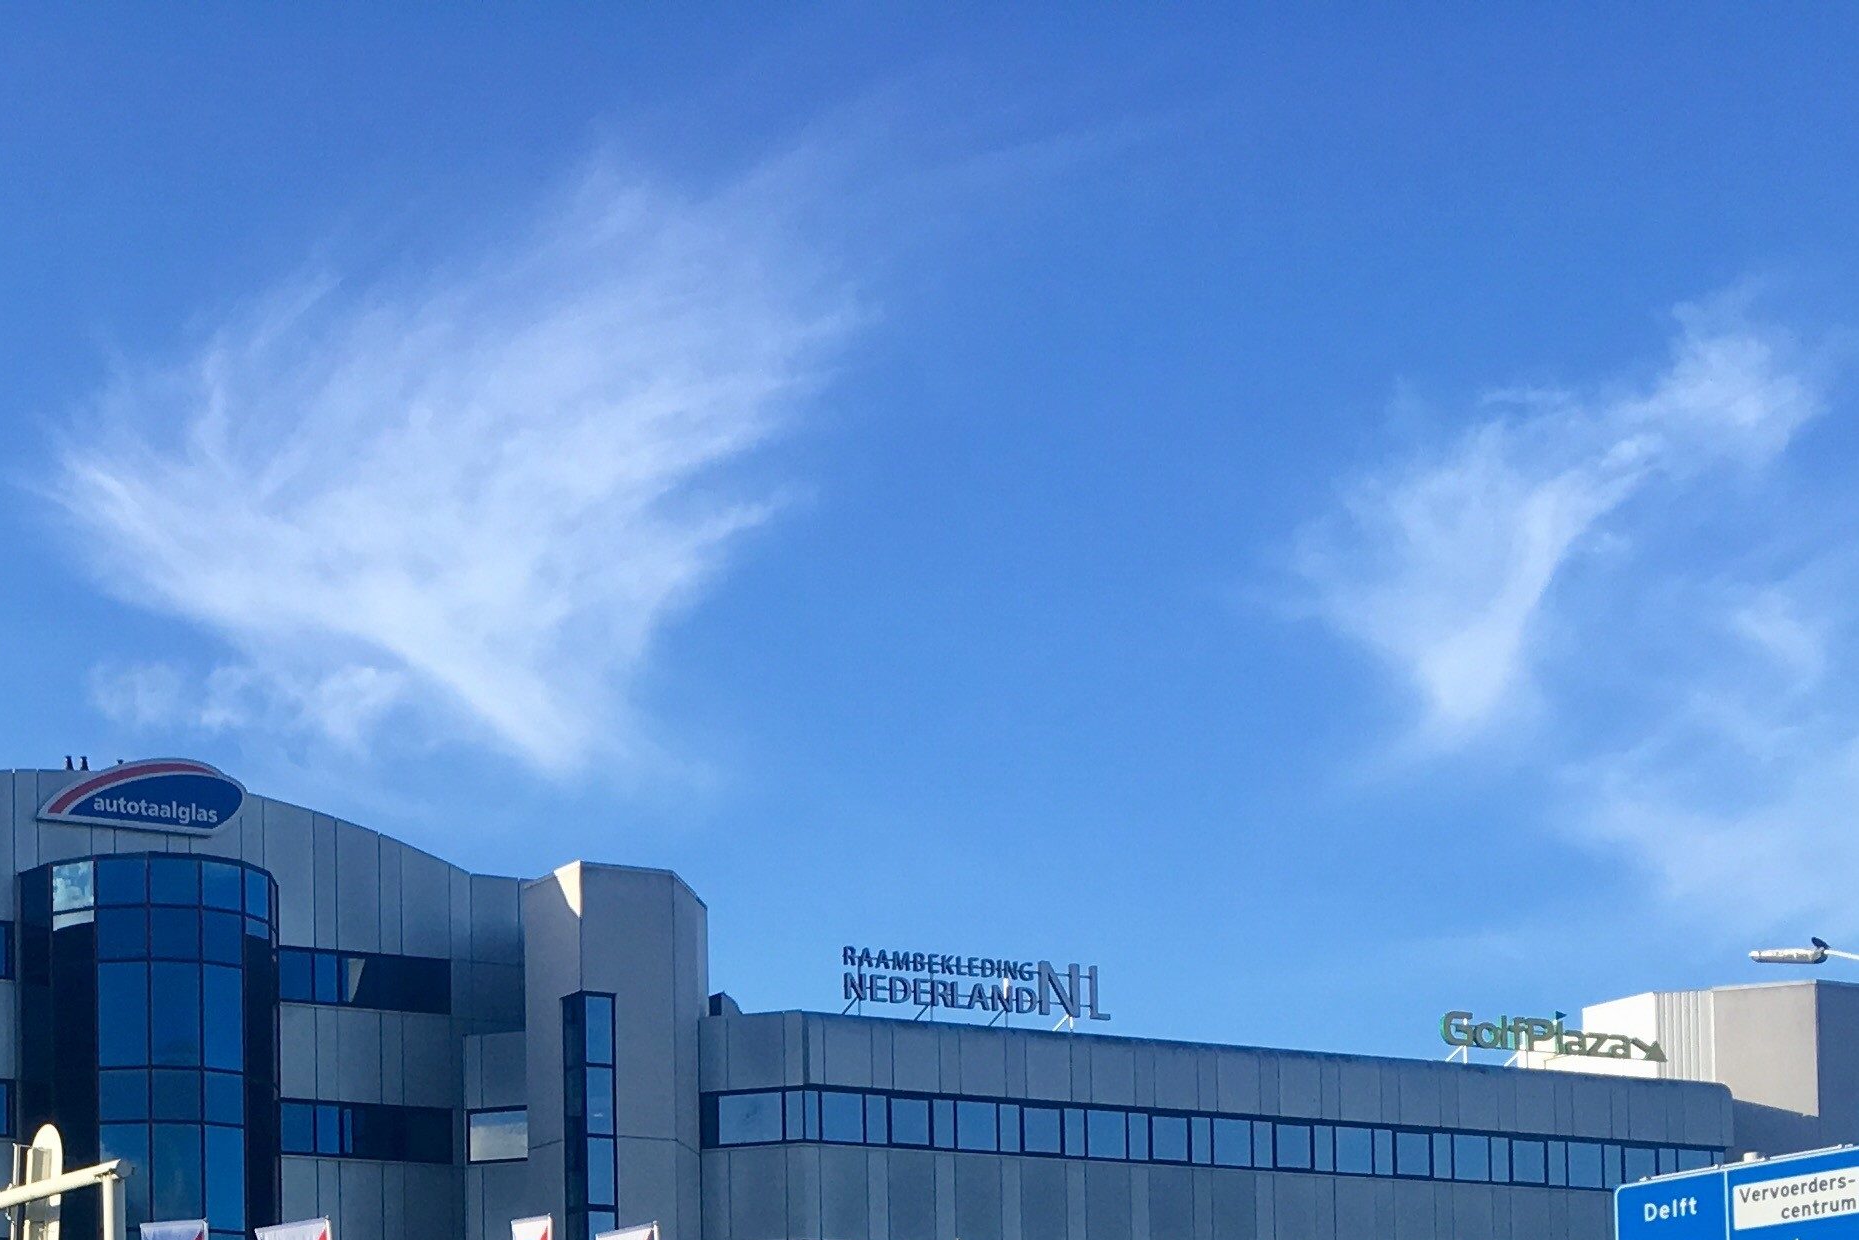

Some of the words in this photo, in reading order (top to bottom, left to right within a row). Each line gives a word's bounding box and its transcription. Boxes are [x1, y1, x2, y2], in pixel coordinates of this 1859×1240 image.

[93, 796, 219, 825] autotaalglas
[842, 945, 1034, 982] RAAMBEKLEDING
[843, 971, 1039, 1014] NEDERLAND
[1037, 959, 1111, 1021] NL
[1440, 1010, 1632, 1060] GolfPlaza
[1739, 1175, 1856, 1205] Vervoerders-
[1644, 1196, 1698, 1223] Delft
[1780, 1196, 1857, 1220] centrum
